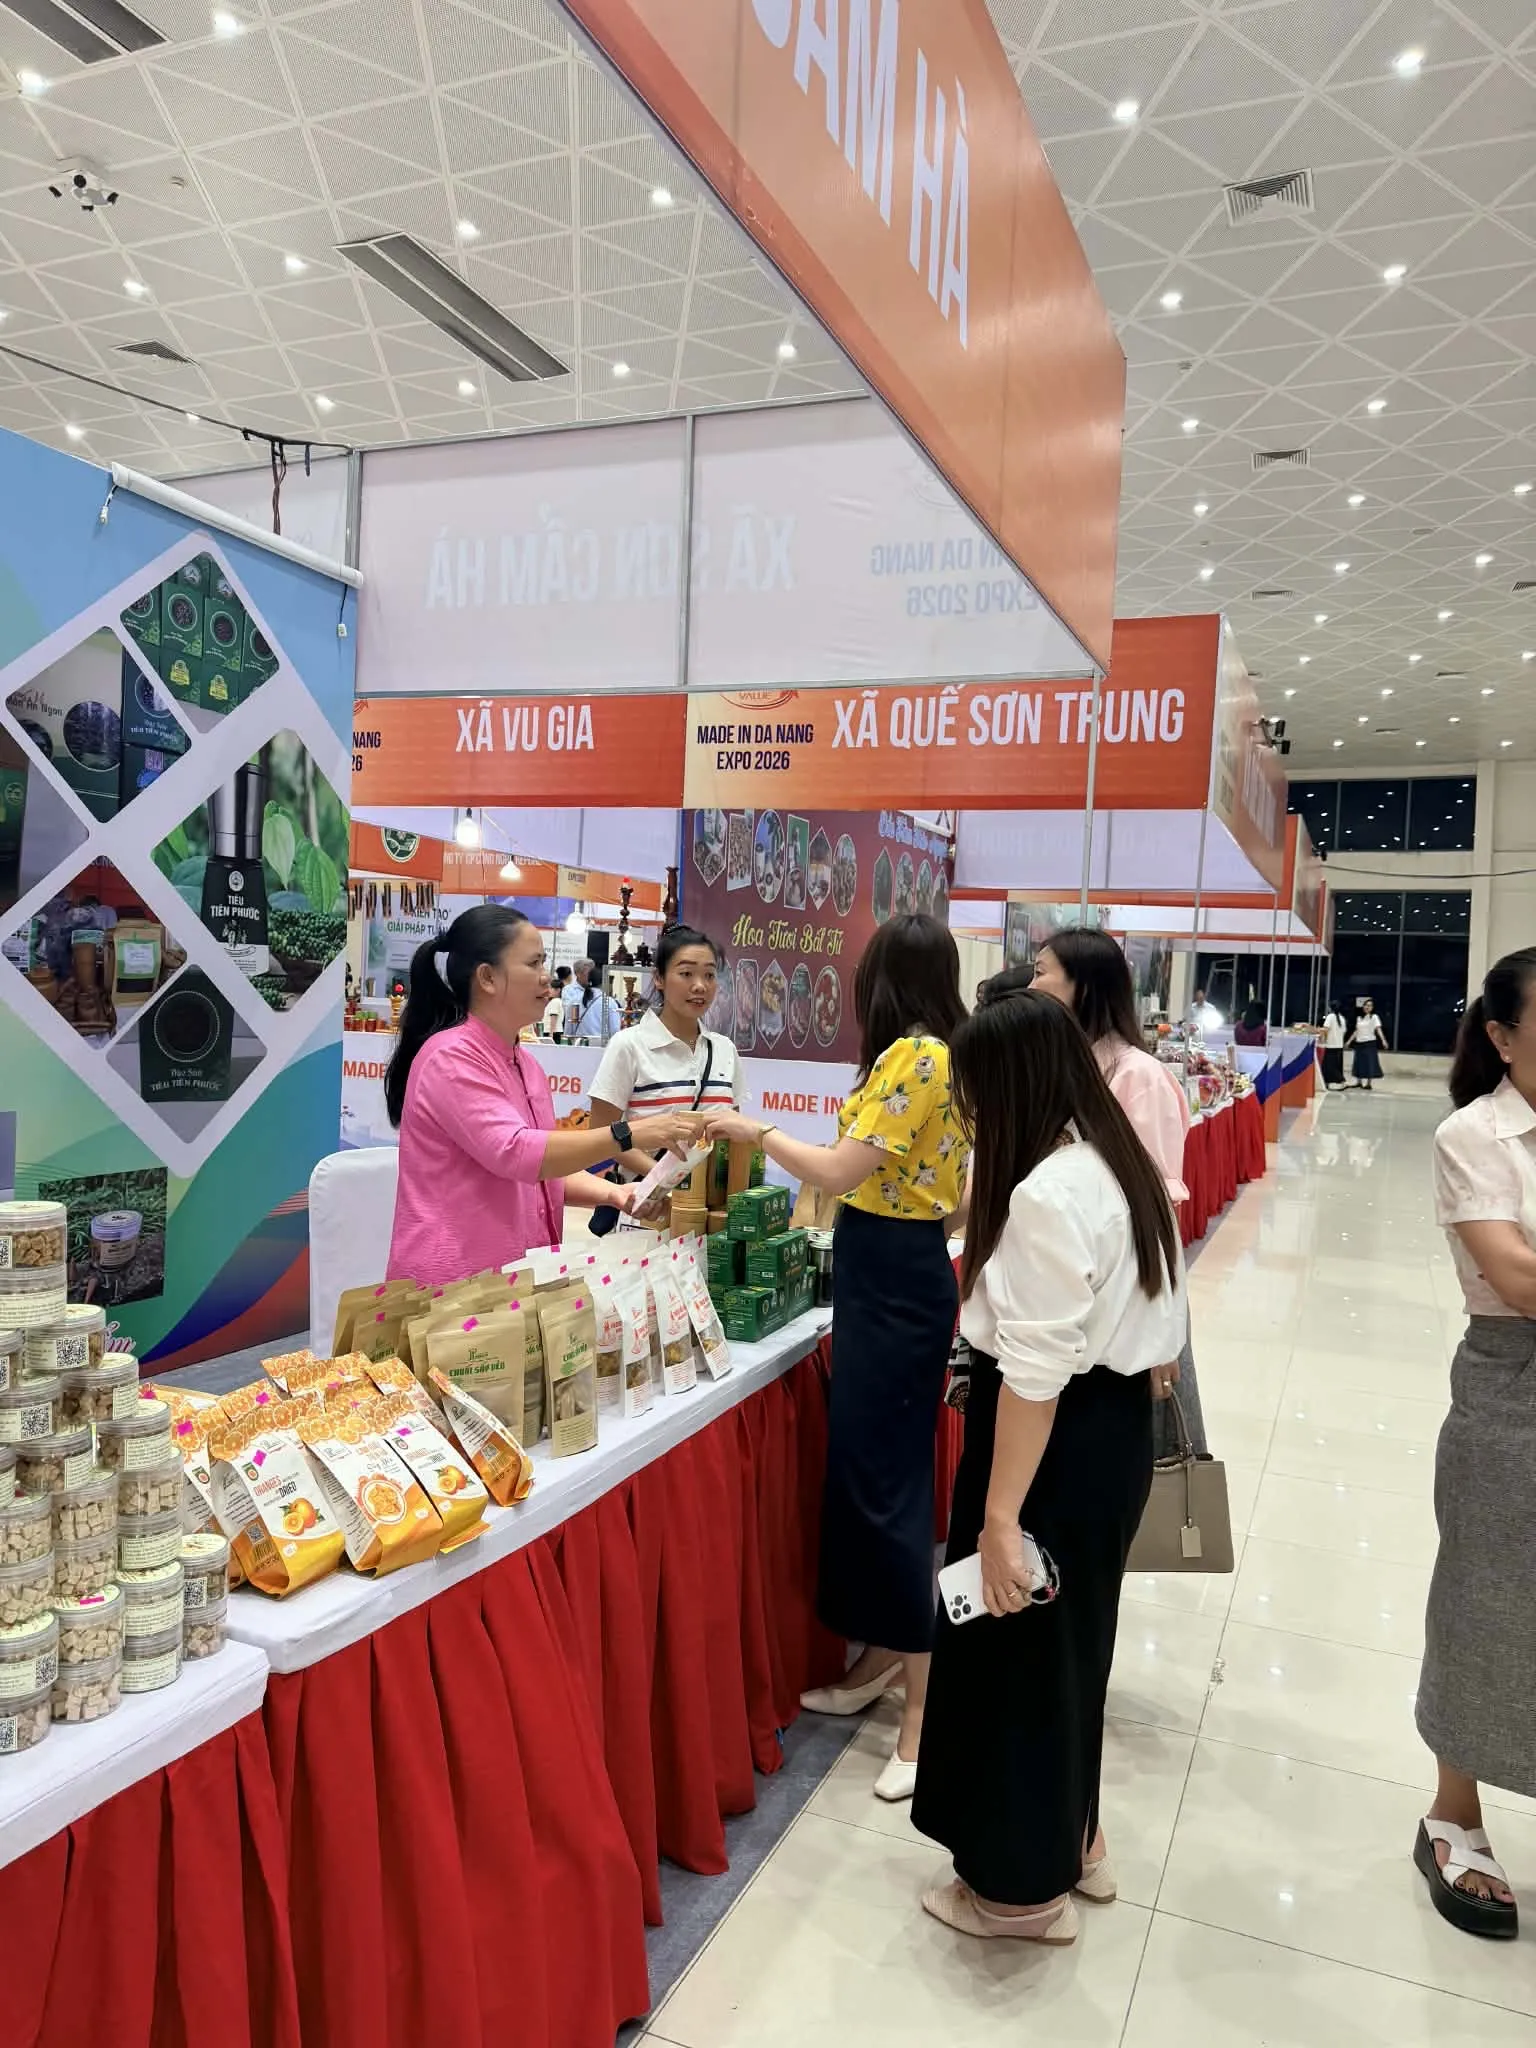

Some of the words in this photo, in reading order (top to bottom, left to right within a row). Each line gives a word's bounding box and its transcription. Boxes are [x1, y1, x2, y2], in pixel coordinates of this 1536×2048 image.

[909, 47, 968, 351] HÀ
[455, 700, 494, 752] XÃ
[502, 706, 540, 752] VU
[547, 704, 595, 751] GIA
[831, 689, 880, 749] XÃ
[889, 683, 966, 750] QUẾ
[968, 690, 1043, 746] SƠN
[1055, 688, 1186, 744] TRUNG
[697, 725, 735, 745] MADE
[738, 724, 751, 744] IN
[754, 724, 774, 744] DA
[776, 723, 814, 744] NANG
[717, 751, 751, 770] EXPO
[754, 751, 790, 770] 2026
[732, 913, 764, 947] Hoa
[762, 1091, 819, 1113] MADE
[823, 1096, 844, 1115] IN
